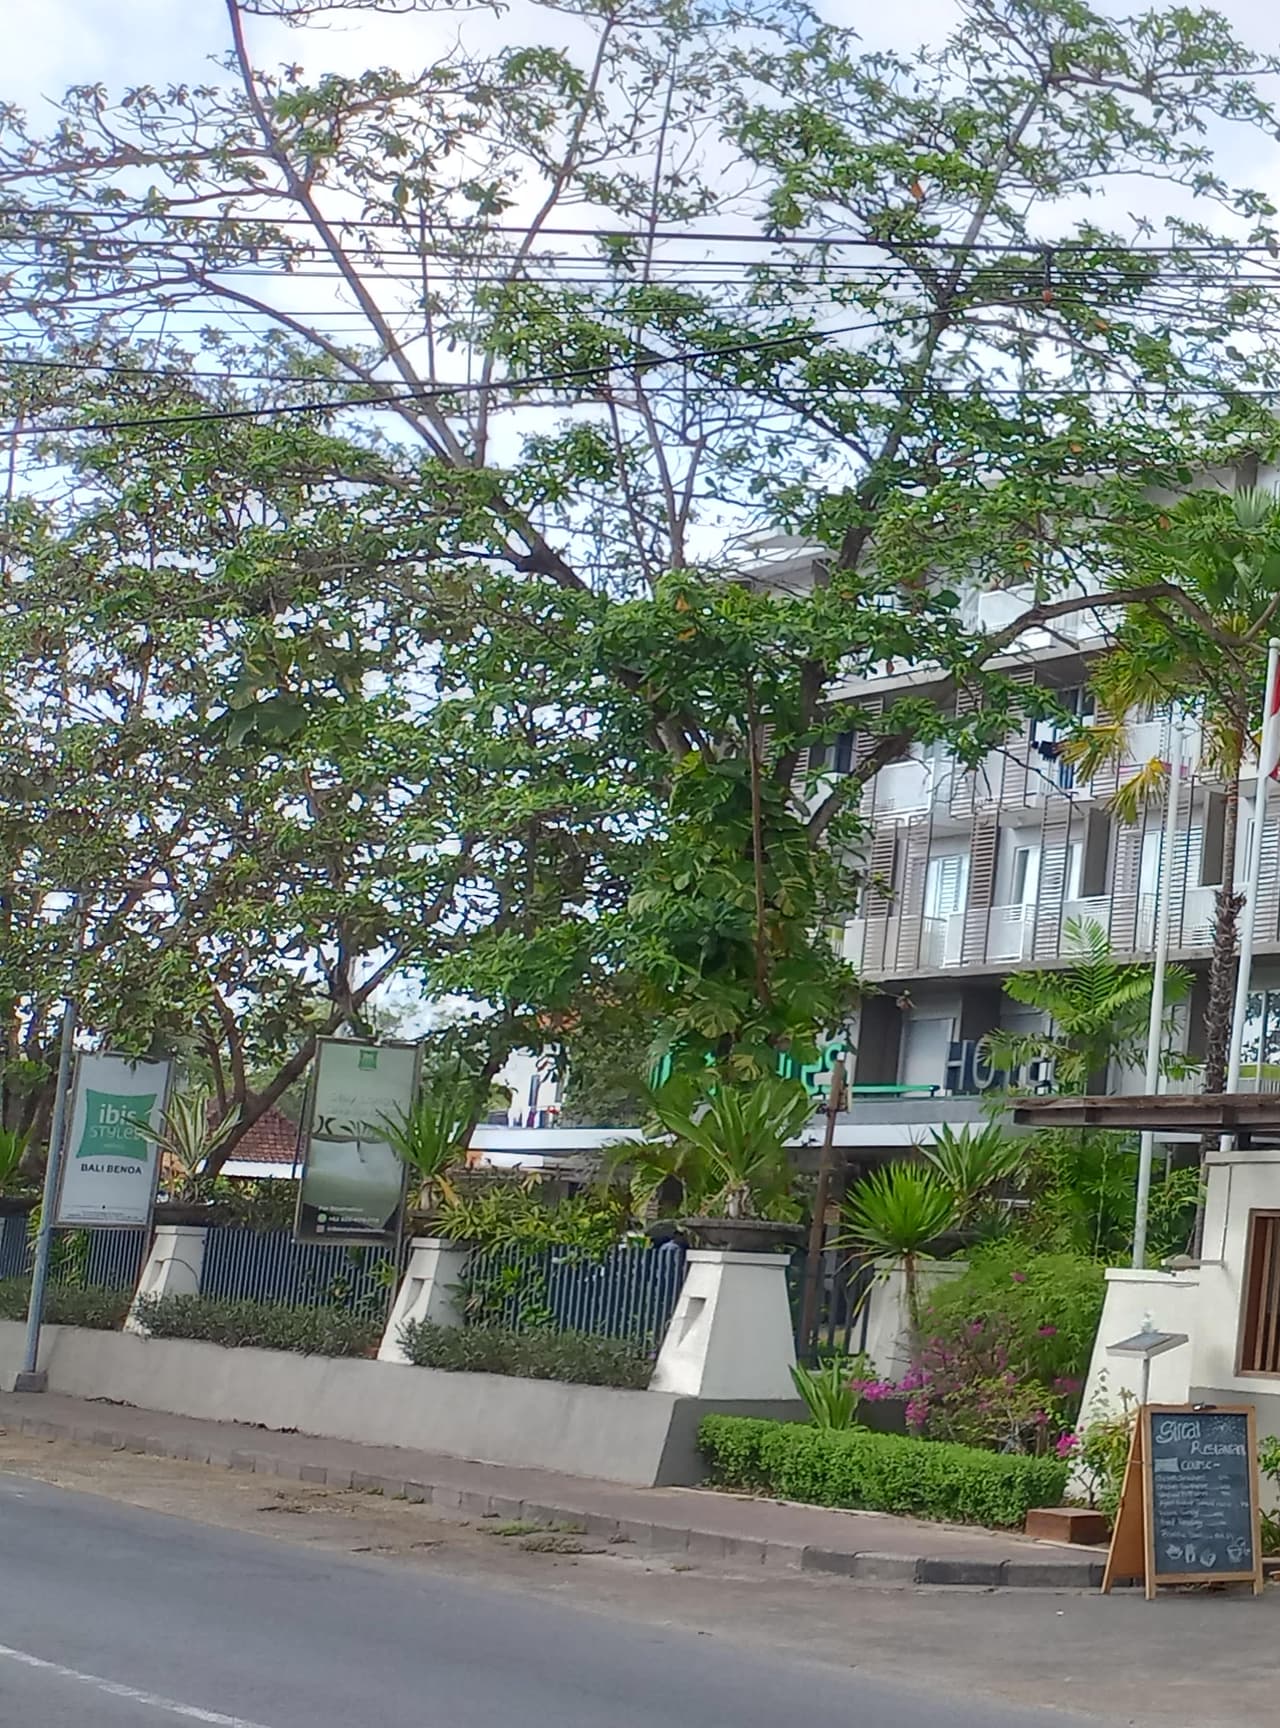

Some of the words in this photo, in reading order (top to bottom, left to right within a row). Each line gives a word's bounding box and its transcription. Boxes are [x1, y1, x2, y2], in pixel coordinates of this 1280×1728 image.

[942, 1038, 1062, 1091] HOE
[99, 1103, 137, 1126] ibis
[80, 1163, 104, 1173] BALI
[106, 1164, 142, 1175] BENOA
